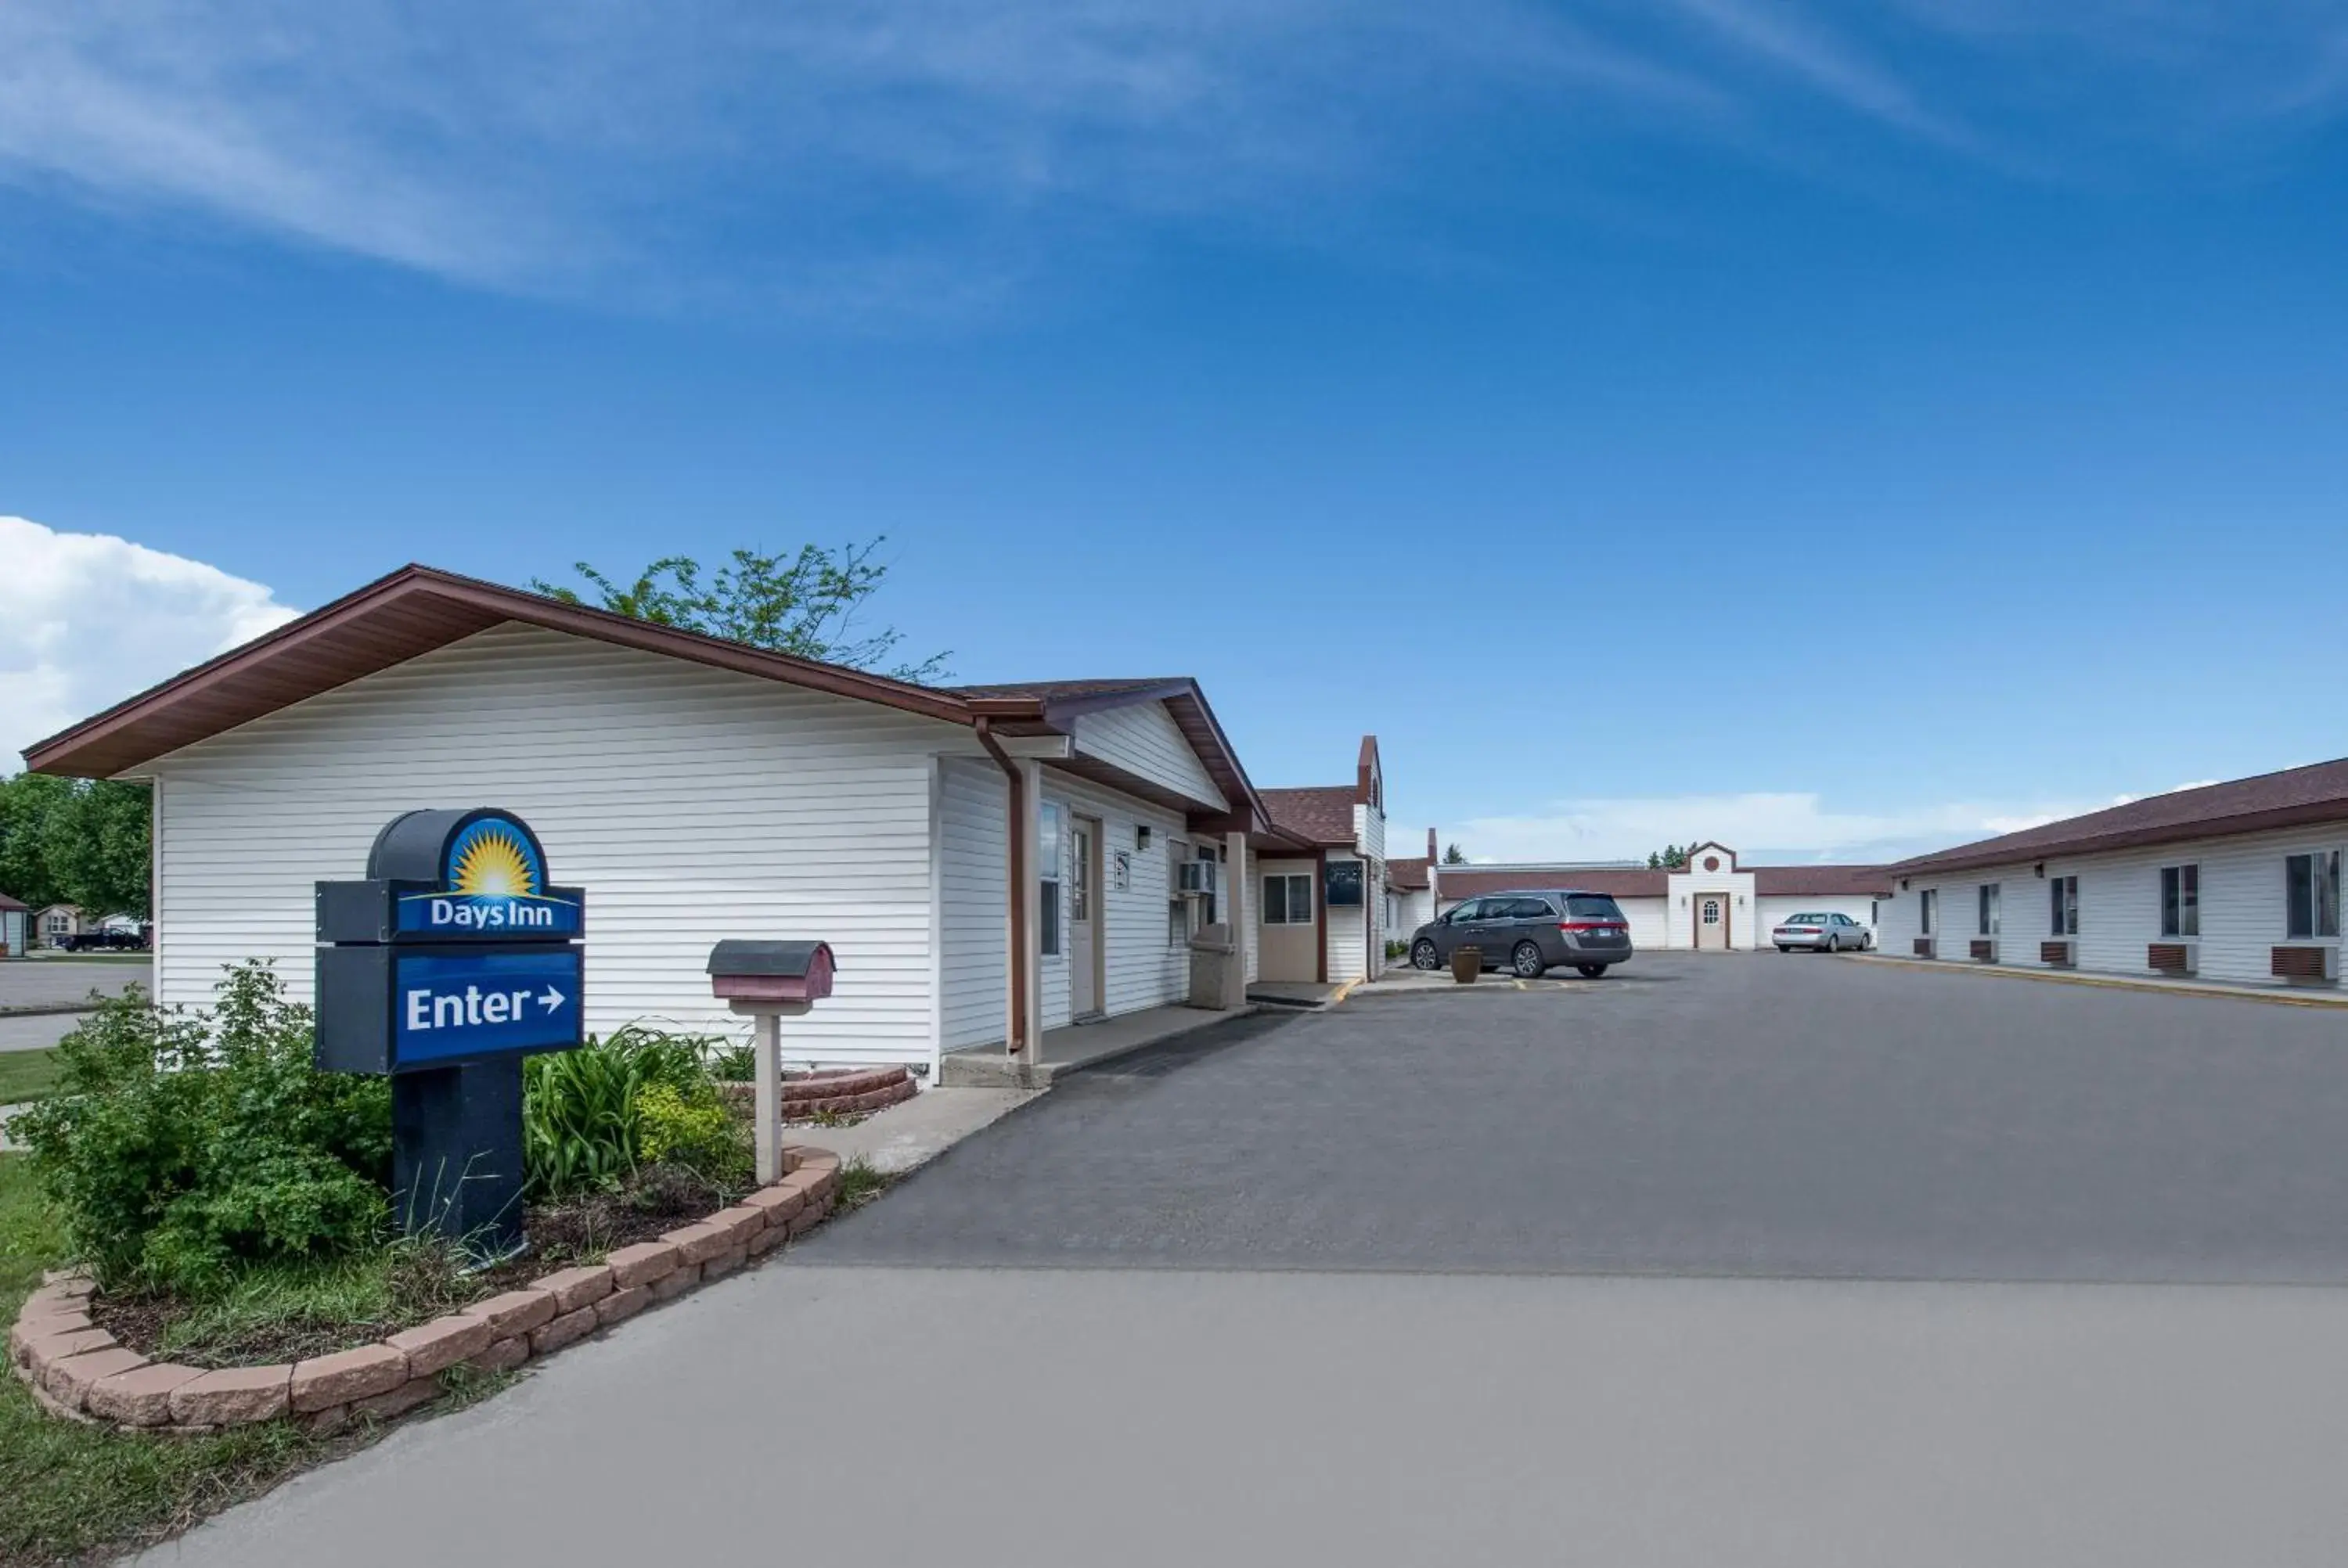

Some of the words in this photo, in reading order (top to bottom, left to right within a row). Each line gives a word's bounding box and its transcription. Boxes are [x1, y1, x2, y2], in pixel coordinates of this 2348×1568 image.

[431, 899, 504, 929] Days
[509, 901, 553, 926] Inn
[407, 985, 532, 1030] Enter
